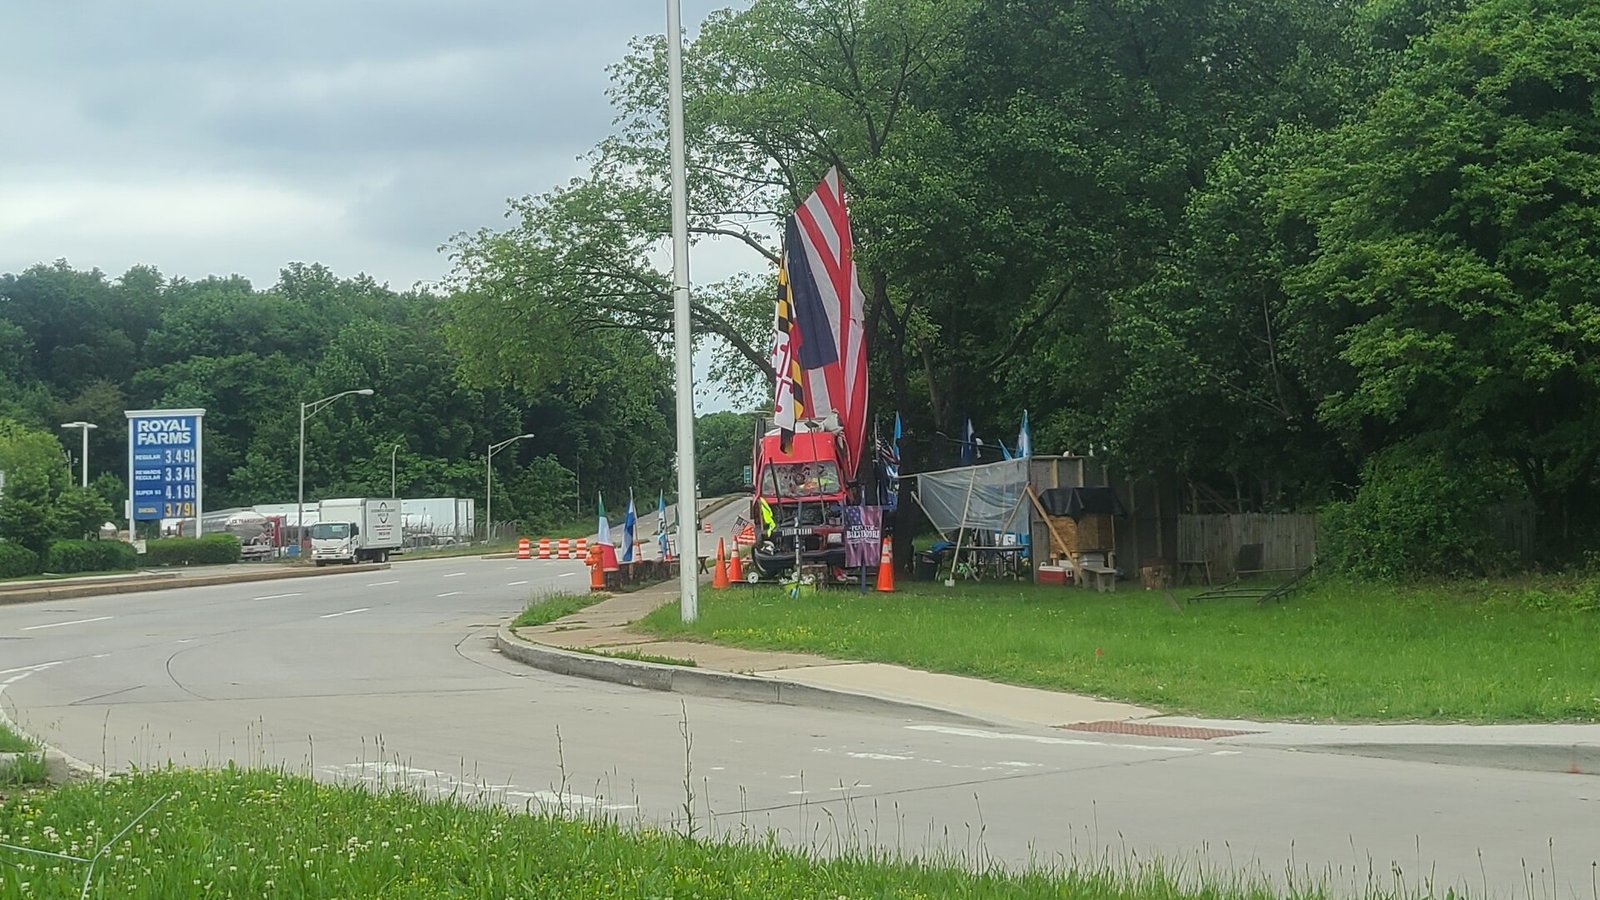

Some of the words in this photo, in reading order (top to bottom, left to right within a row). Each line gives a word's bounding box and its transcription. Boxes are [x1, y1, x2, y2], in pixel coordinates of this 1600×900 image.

[137, 419, 191, 432] ROYAL
[137, 432, 191, 445] FARMS
[846, 530, 880, 539] BALTIMORE
